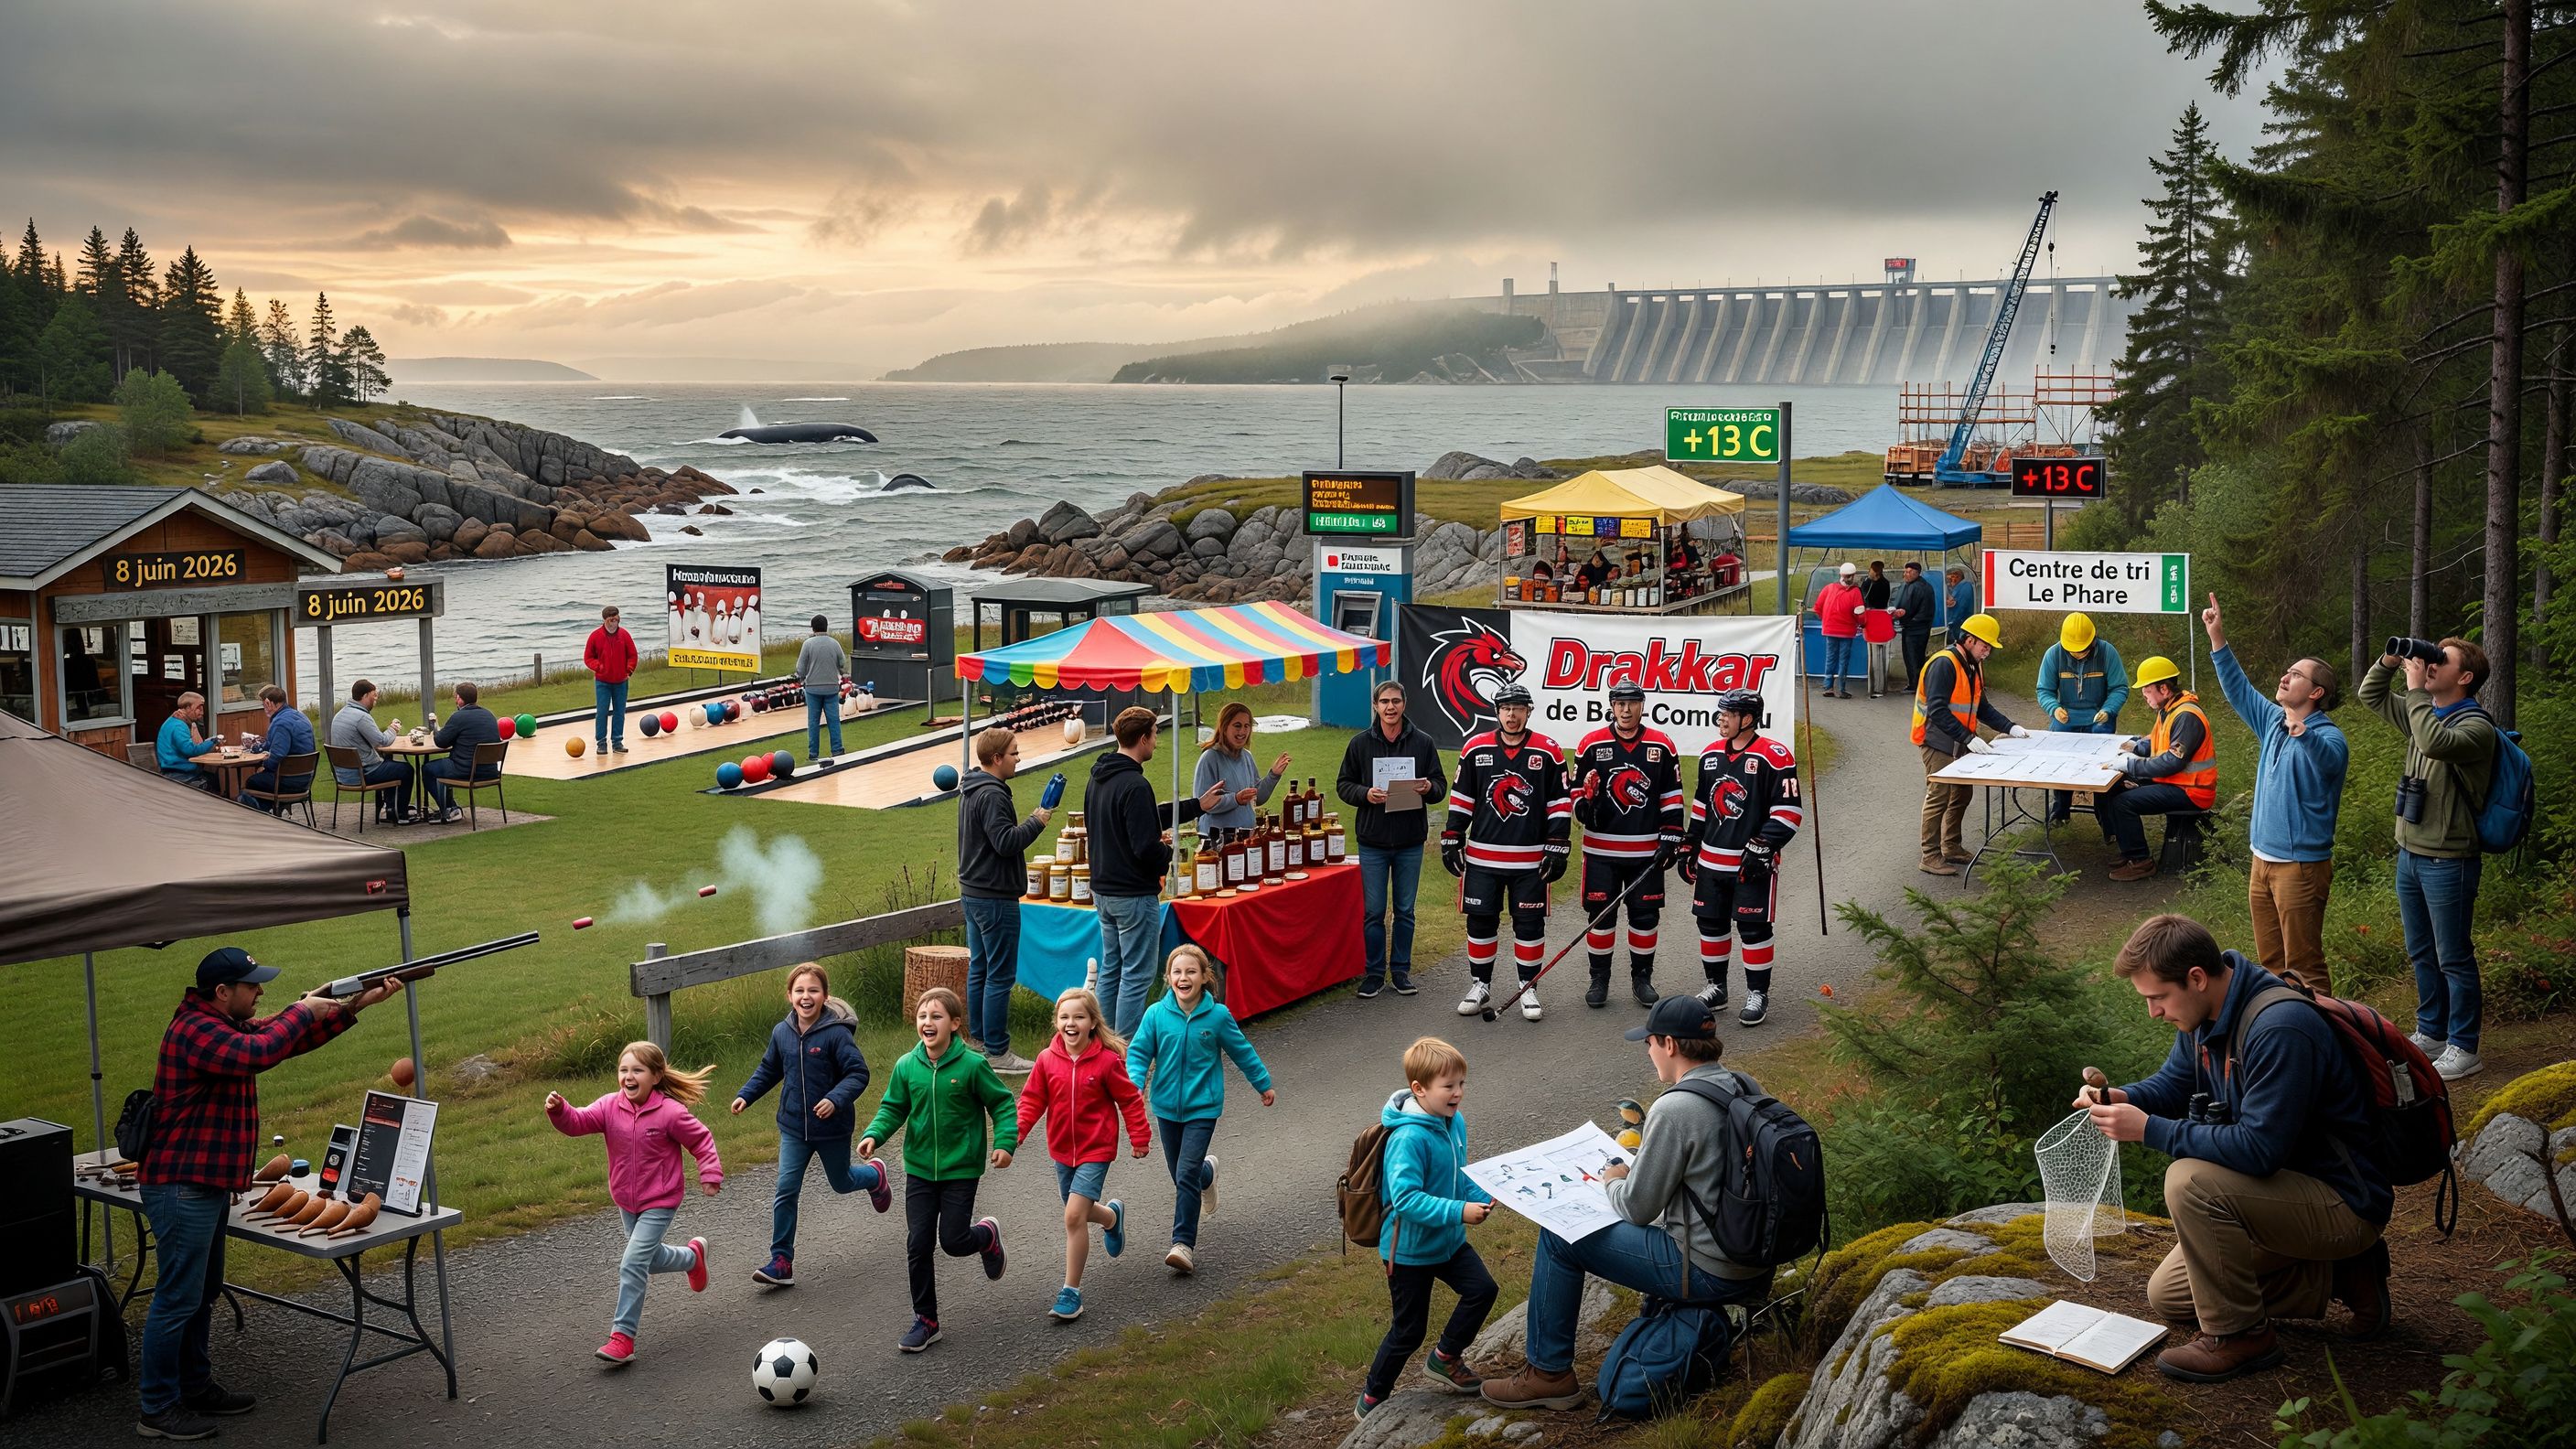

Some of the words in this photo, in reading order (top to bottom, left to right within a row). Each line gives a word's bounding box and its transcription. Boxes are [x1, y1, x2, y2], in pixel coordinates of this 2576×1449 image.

[1683, 424, 1741, 456] +13
[1749, 424, 1772, 457] C
[2023, 465, 2069, 491] +13
[2076, 466, 2094, 491] C
[115, 559, 130, 583] 8
[134, 557, 177, 587] juin
[182, 553, 238, 579] 2026
[2009, 558, 2083, 579] Centre
[2090, 560, 2118, 580] de
[2126, 561, 2150, 580] tri
[307, 594, 321, 617] 8
[326, 592, 367, 620] juin
[373, 588, 424, 613] 2026
[2028, 583, 2054, 603] Le
[2063, 583, 2129, 605] Phare
[1542, 637, 1779, 695] Drakkar
[1546, 698, 1578, 722] de
